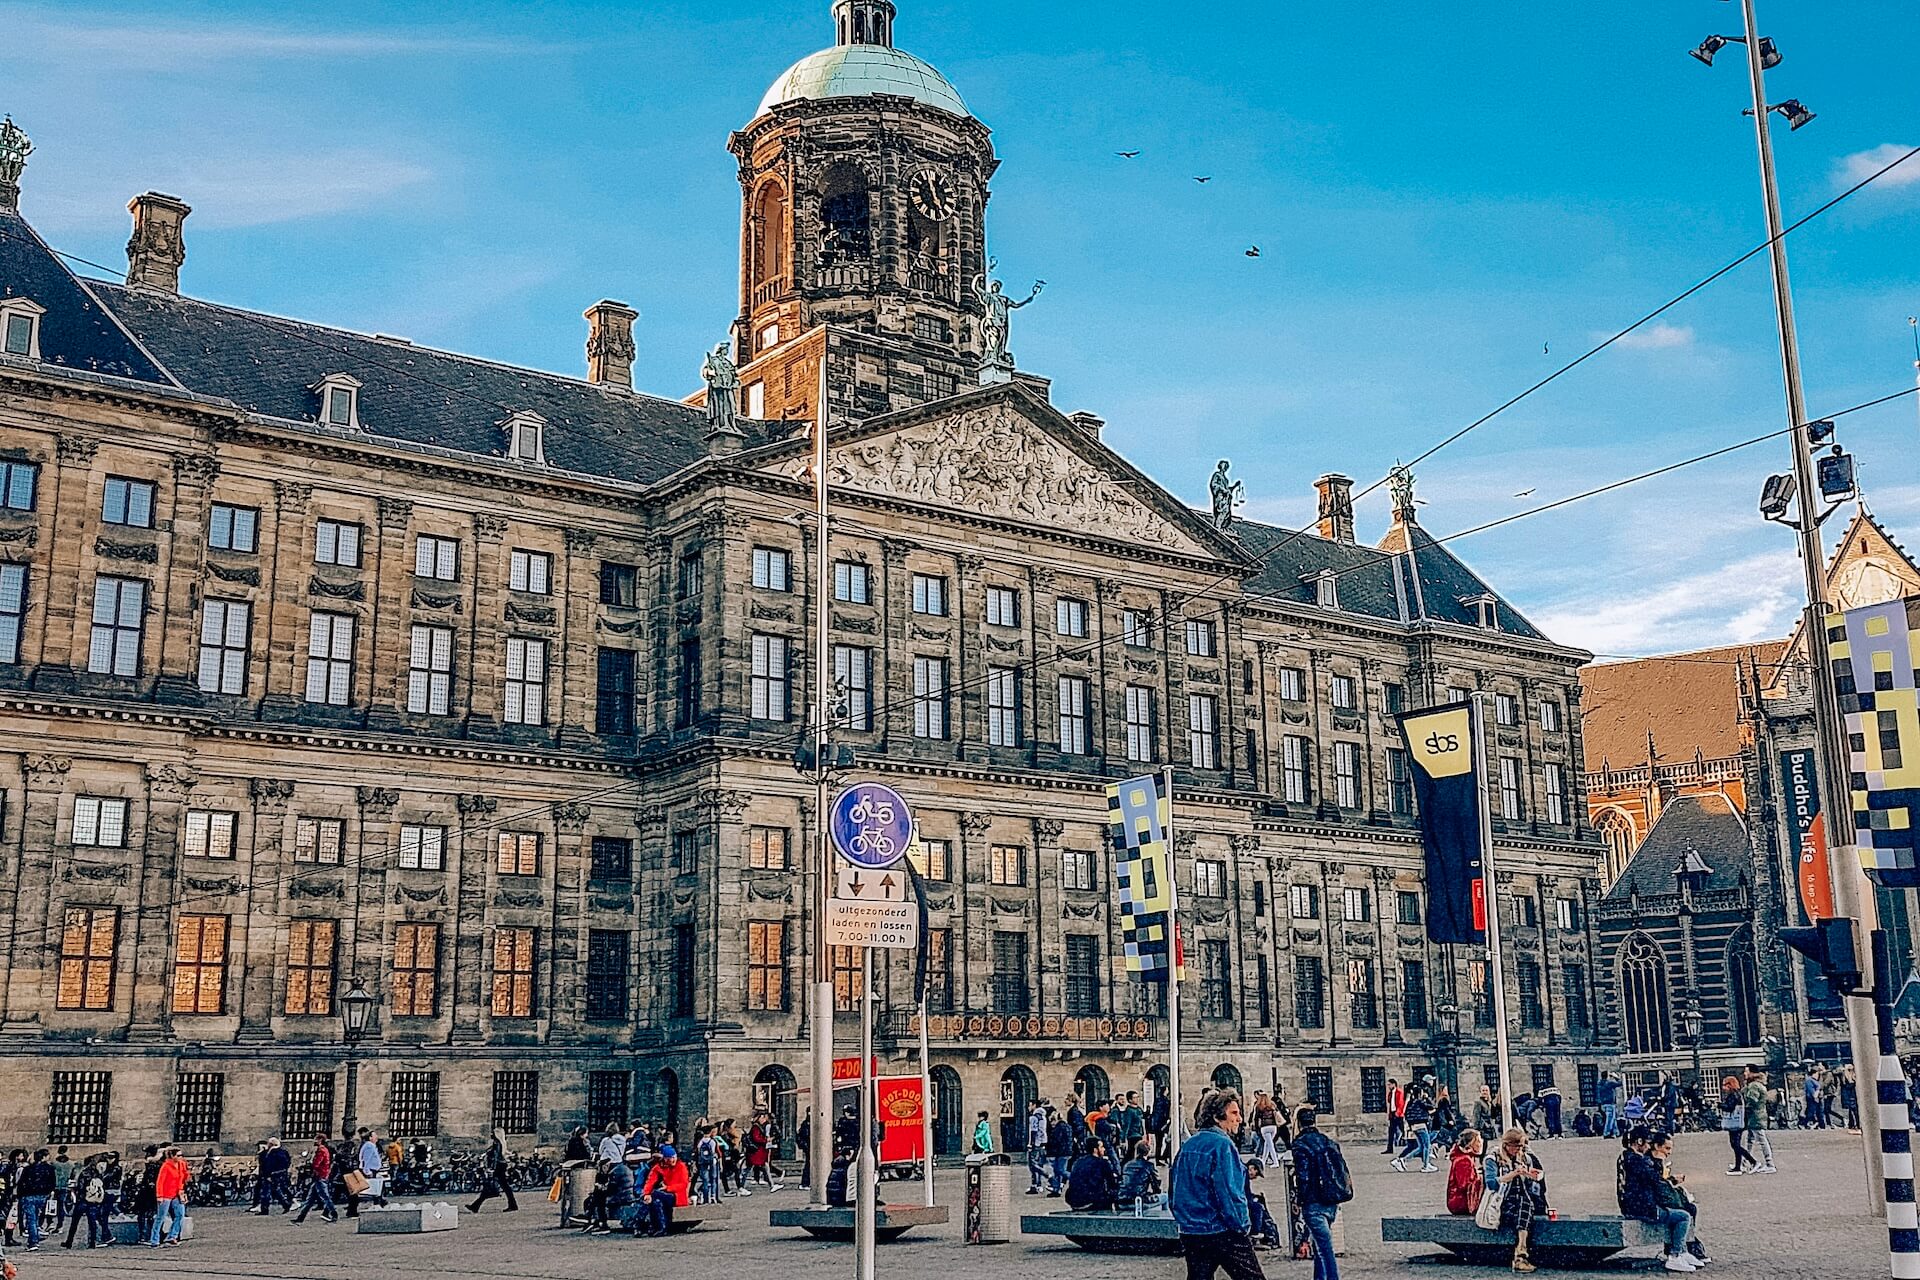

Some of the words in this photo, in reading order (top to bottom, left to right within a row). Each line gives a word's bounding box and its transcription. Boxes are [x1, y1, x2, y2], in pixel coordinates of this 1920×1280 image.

[1424, 731, 1459, 755] sbs
[1790, 753, 1813, 828] Buddha's
[1799, 832, 1817, 863] Life
[839, 905, 907, 917] uitgezonderd
[832, 918, 860, 928] laden
[864, 921, 877, 929] en
[880, 920, 912, 931] lossen
[899, 935, 906, 944] h
